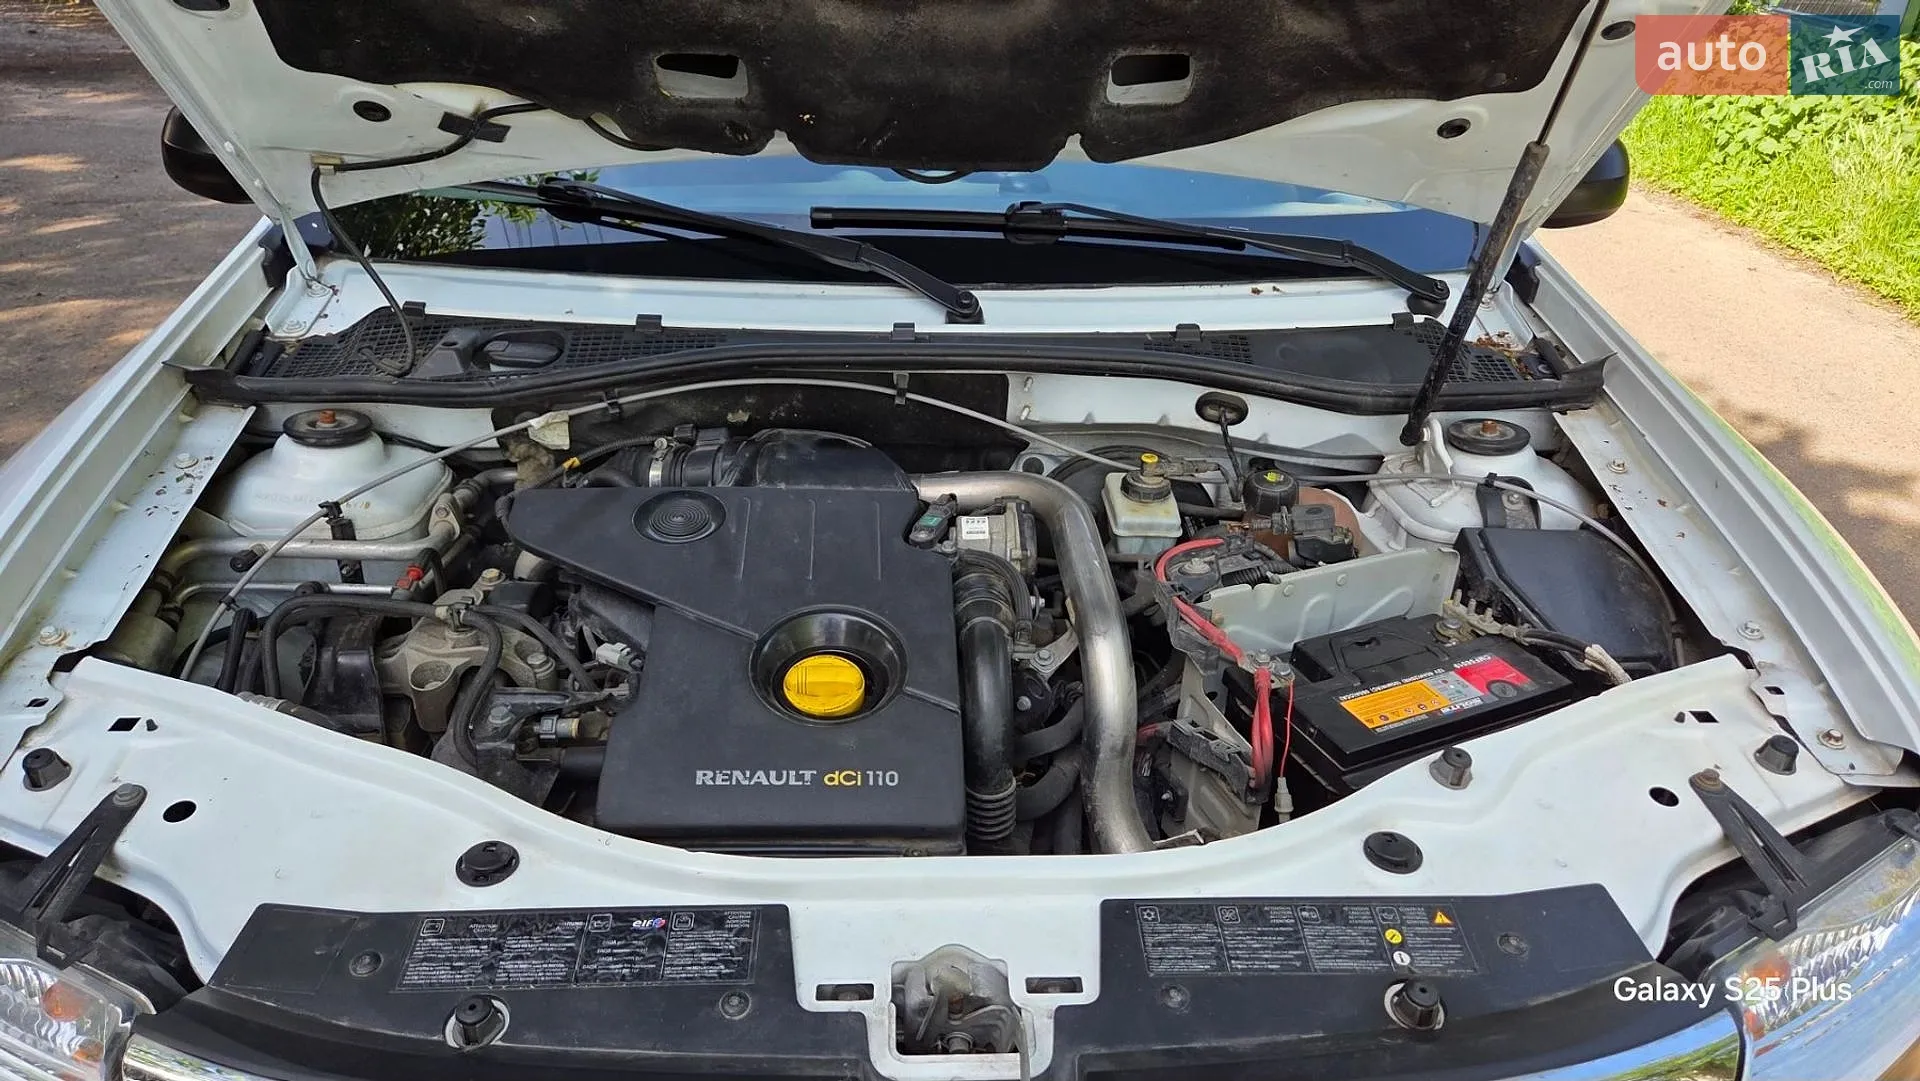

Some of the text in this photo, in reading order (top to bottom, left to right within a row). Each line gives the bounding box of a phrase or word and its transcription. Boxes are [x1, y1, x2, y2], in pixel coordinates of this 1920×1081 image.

[695, 769, 899, 787] RENAULT dCi 110
